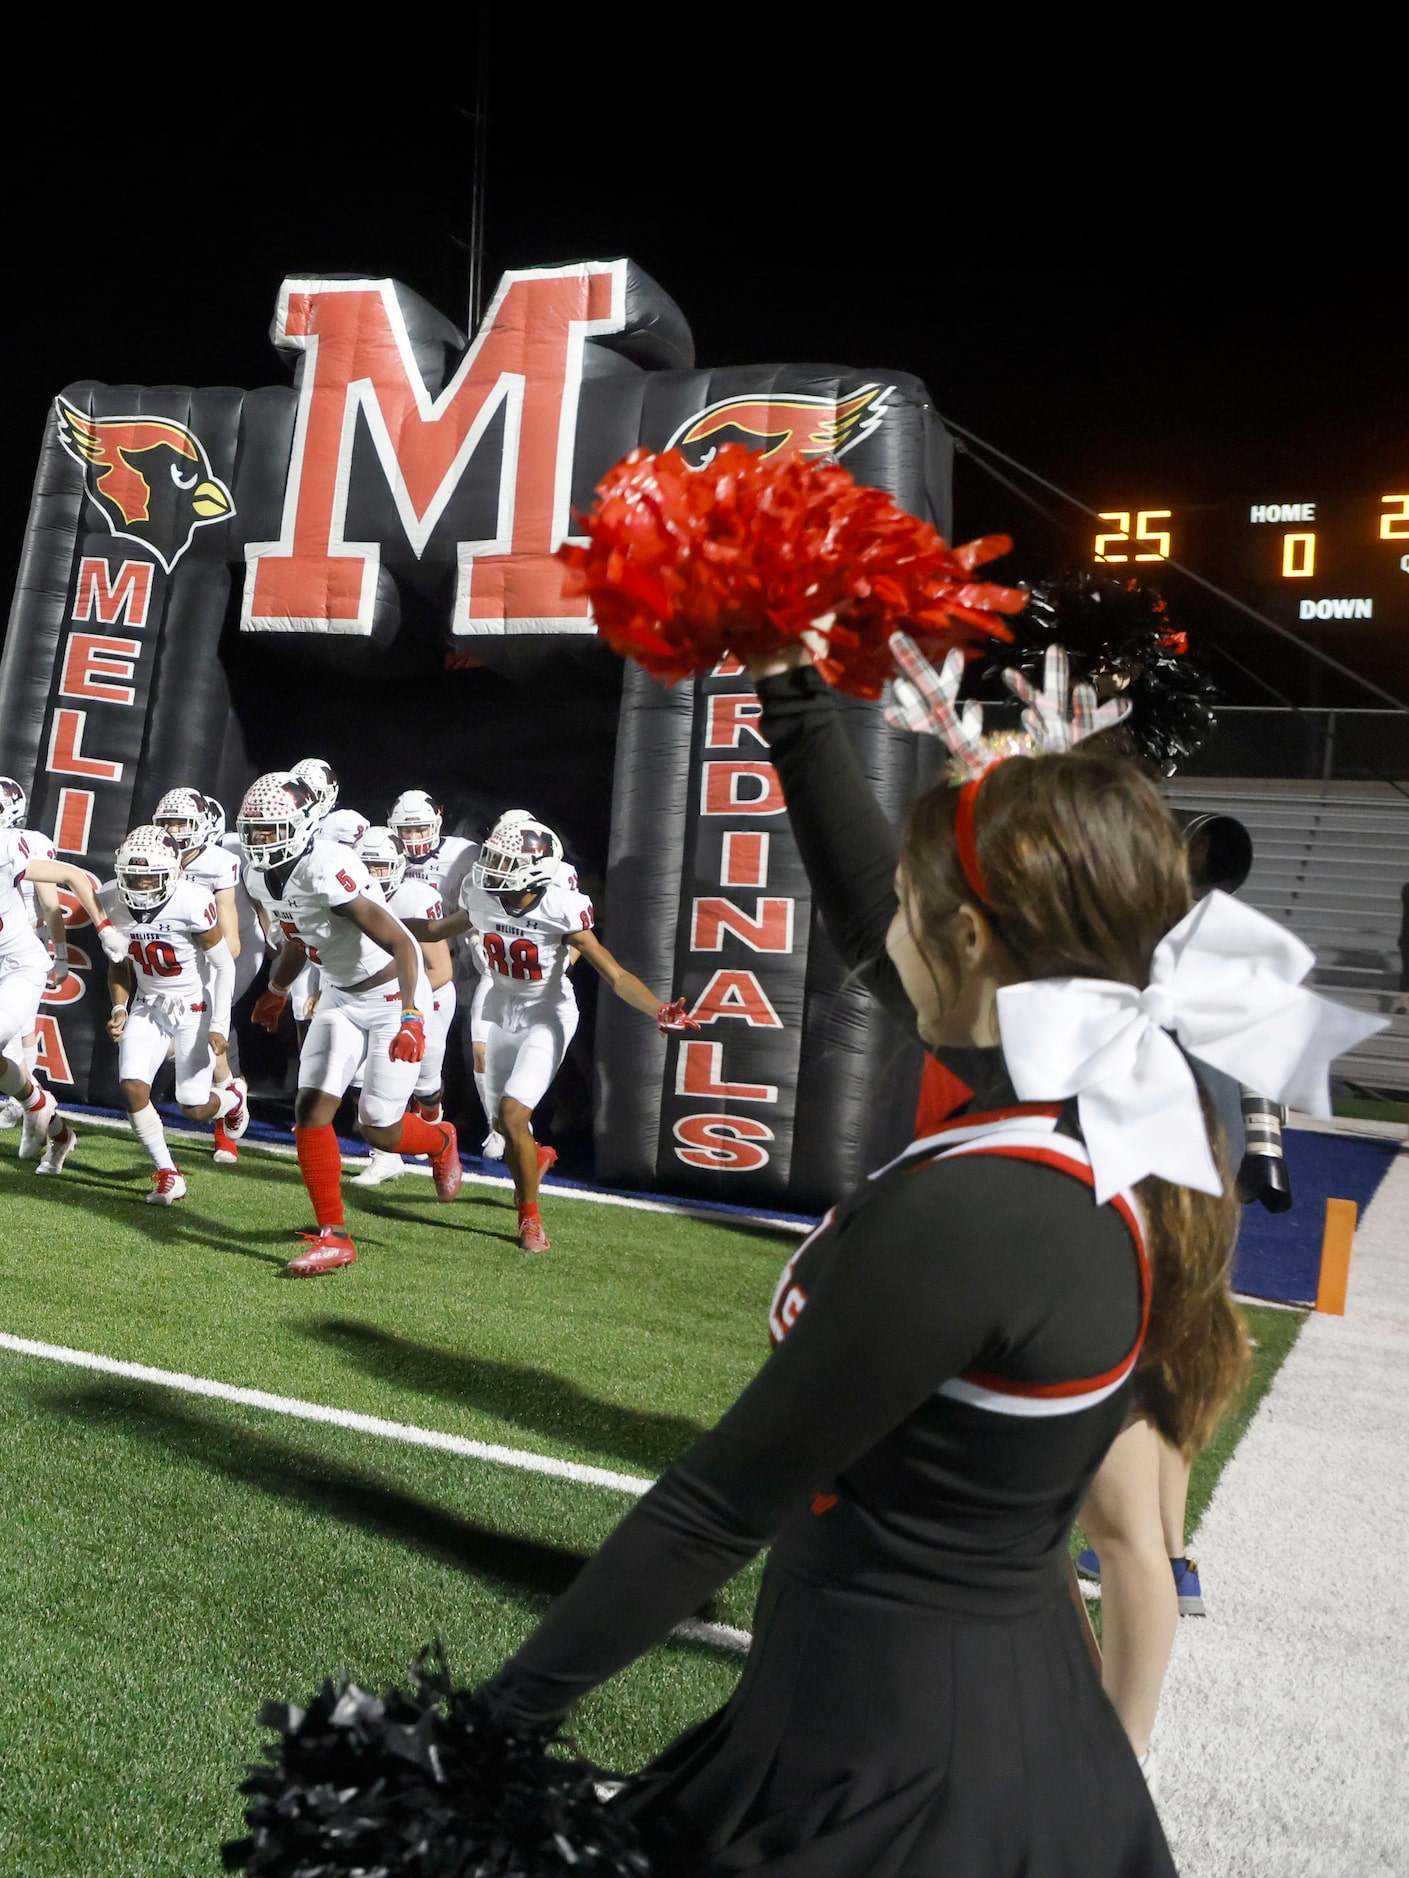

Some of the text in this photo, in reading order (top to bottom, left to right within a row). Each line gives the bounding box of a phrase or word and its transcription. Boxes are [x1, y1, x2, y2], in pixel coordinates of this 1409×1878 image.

[240, 258, 628, 635] M
[1250, 503, 1316, 523] HOME
[1094, 510, 1172, 562] 25
[1282, 533, 1316, 577] 0
[1299, 598, 1373, 620] DOWN
[335, 868, 357, 893] 5
[203, 902, 217, 926] 10
[673, 650, 795, 1172] RDINALS
[130, 932, 160, 941] MELISSA
[496, 923, 525, 937] MELISSA
[128, 940, 183, 978] 10
[484, 933, 543, 981] 88
